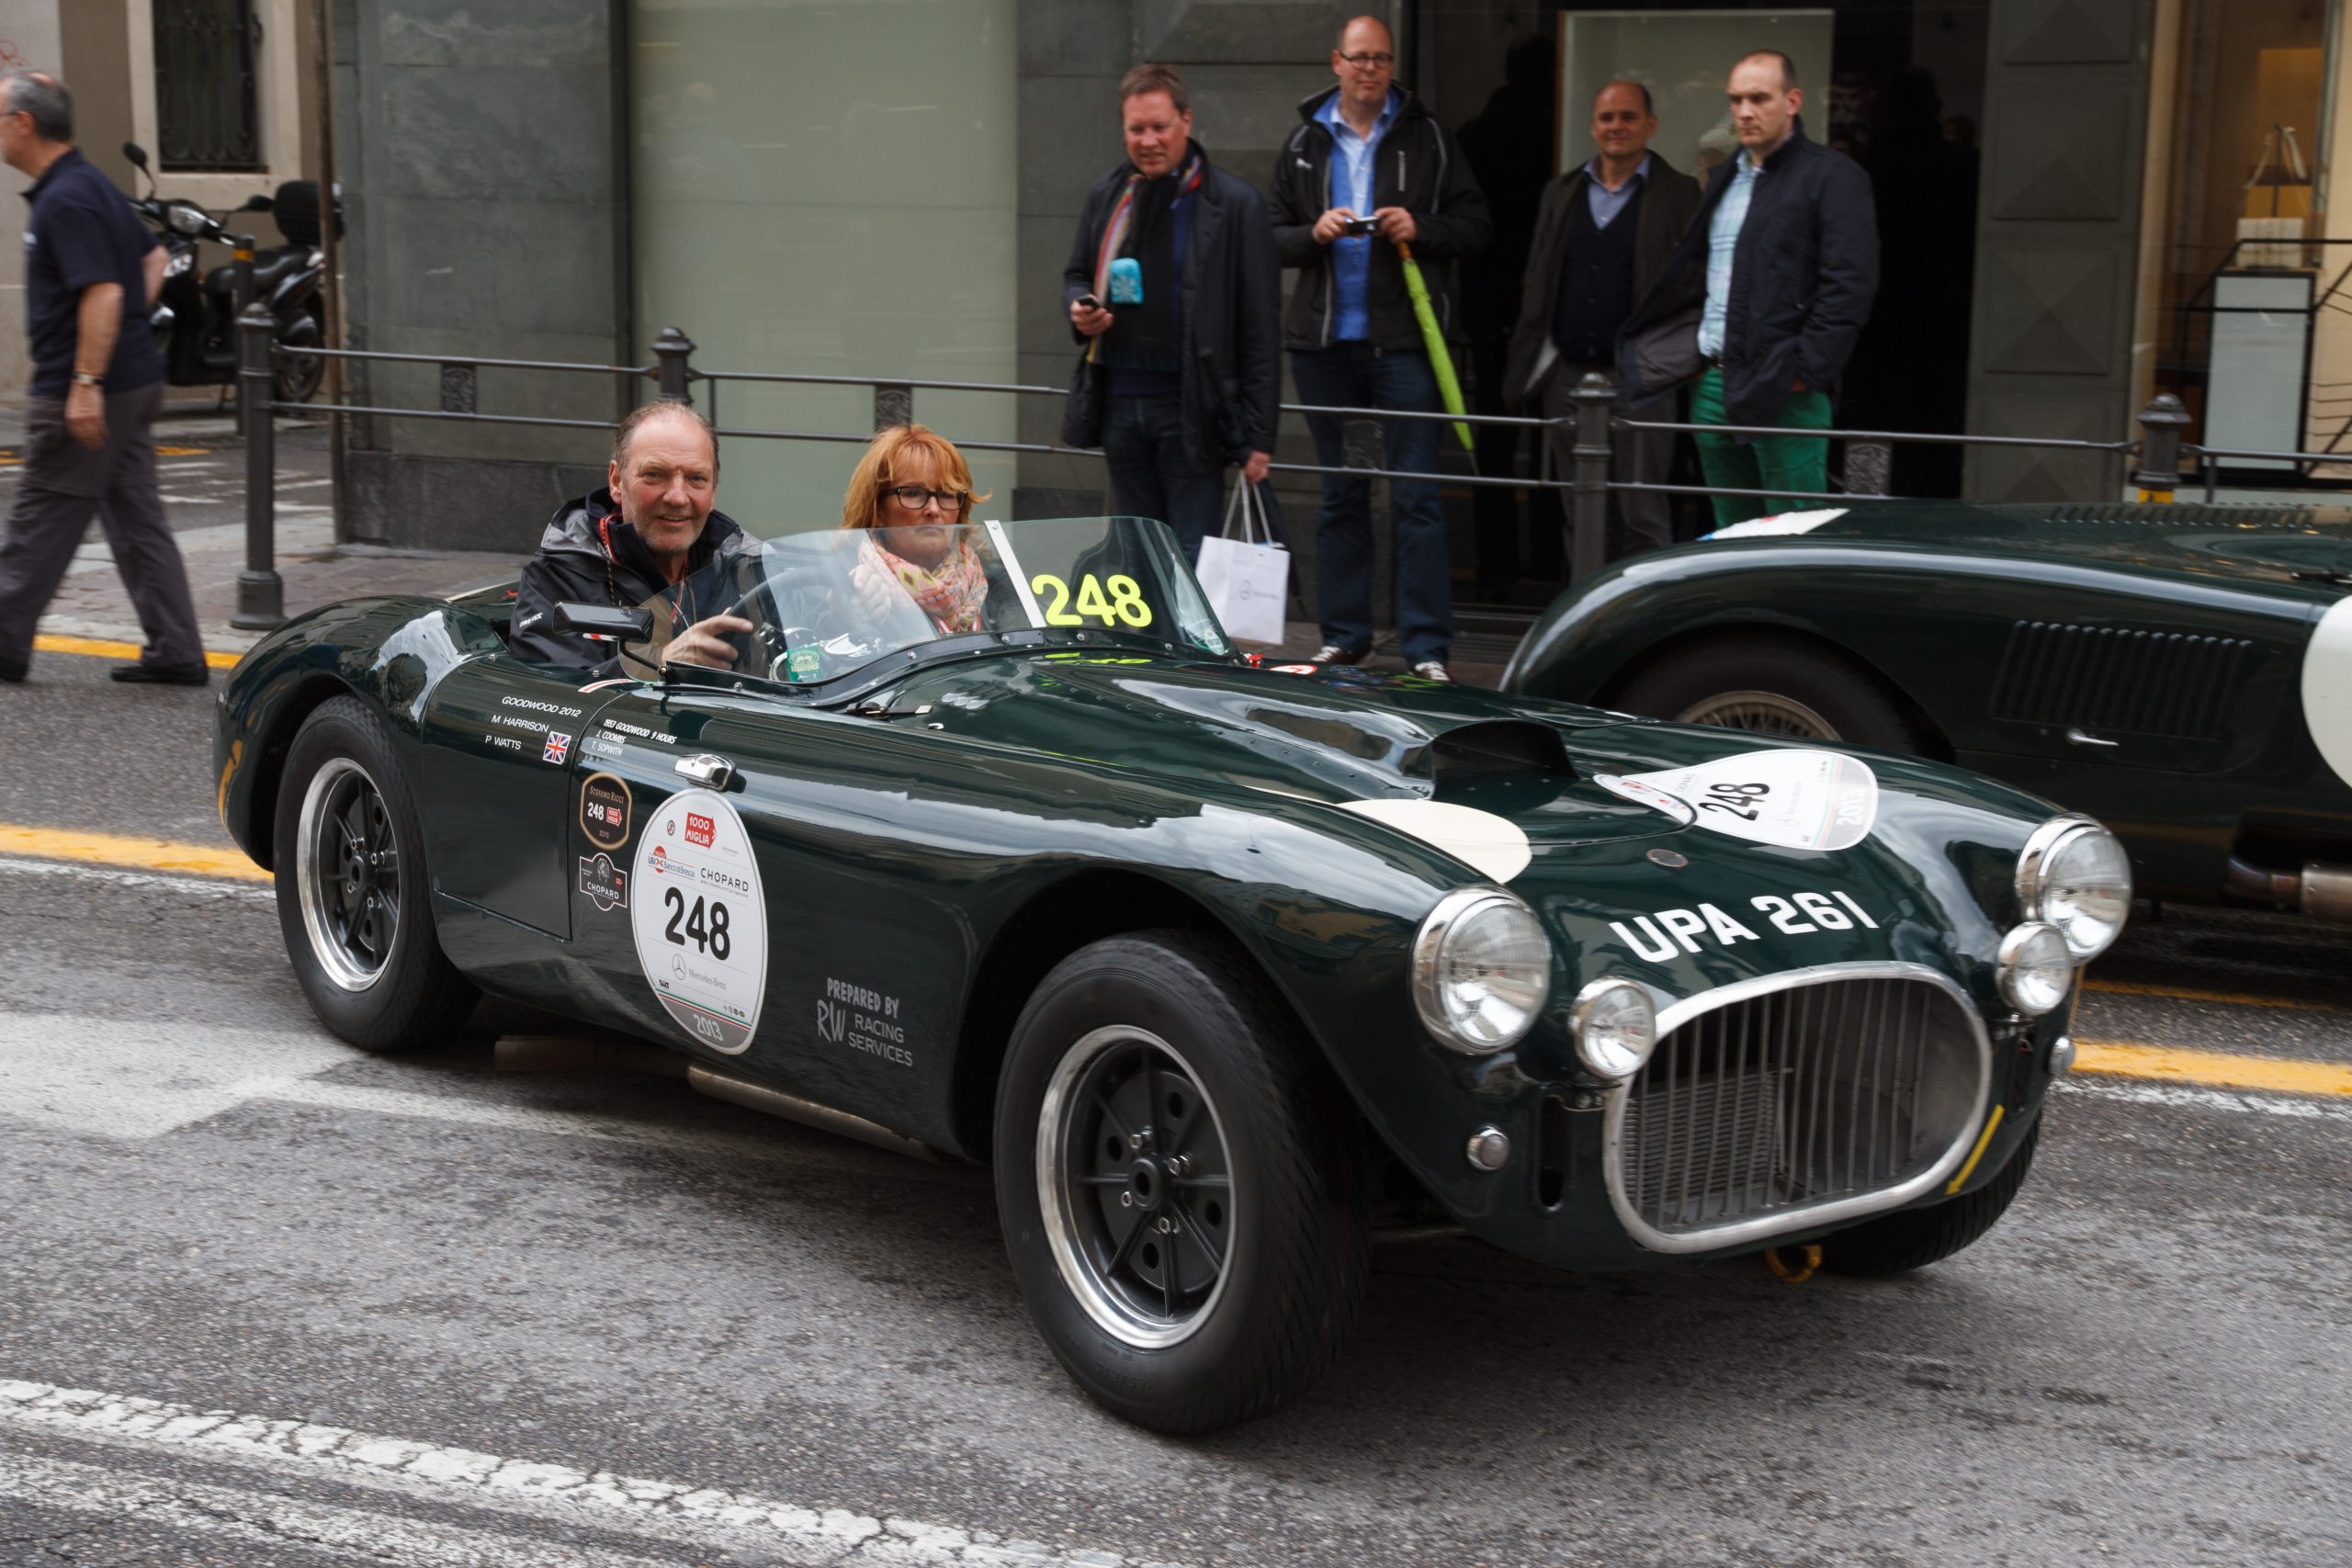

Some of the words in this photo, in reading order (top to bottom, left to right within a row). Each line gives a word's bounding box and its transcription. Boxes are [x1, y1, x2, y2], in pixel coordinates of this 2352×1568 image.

[1032, 573, 1152, 627] 248
[502, 696, 559, 714] GOODWOOD
[559, 706, 582, 718] 2012
[492, 715, 501, 724] M
[503, 716, 551, 733] HARRISON
[615, 722, 650, 738] GOODWOOD
[650, 731, 658, 739] 9
[655, 732, 677, 744] HOURS
[485, 735, 492, 744] P
[493, 736, 522, 750] WATTS
[591, 740, 597, 750] T.
[597, 742, 624, 757] SOPWITH
[602, 731, 627, 744] COOMBS
[587, 802, 604, 820] 248
[1699, 783, 1770, 821] 248
[1836, 788, 1866, 825] 2013
[689, 816, 709, 830] 1000
[685, 829, 709, 845] MIGLIA
[587, 882, 619, 899] CHOPARD
[700, 867, 749, 892] CHOPARD
[664, 886, 730, 961] 248
[1609, 903, 1761, 963] UPA
[1750, 891, 1880, 935] 261
[689, 967, 727, 990] Mercedes-Benz
[827, 977, 881, 1012] PREPARED
[885, 996, 899, 1019] BY
[693, 1013, 723, 1042] 2013
[817, 998, 845, 1043] RW
[854, 1013, 904, 1043] RACING
[848, 1032, 913, 1066] SERVICES
